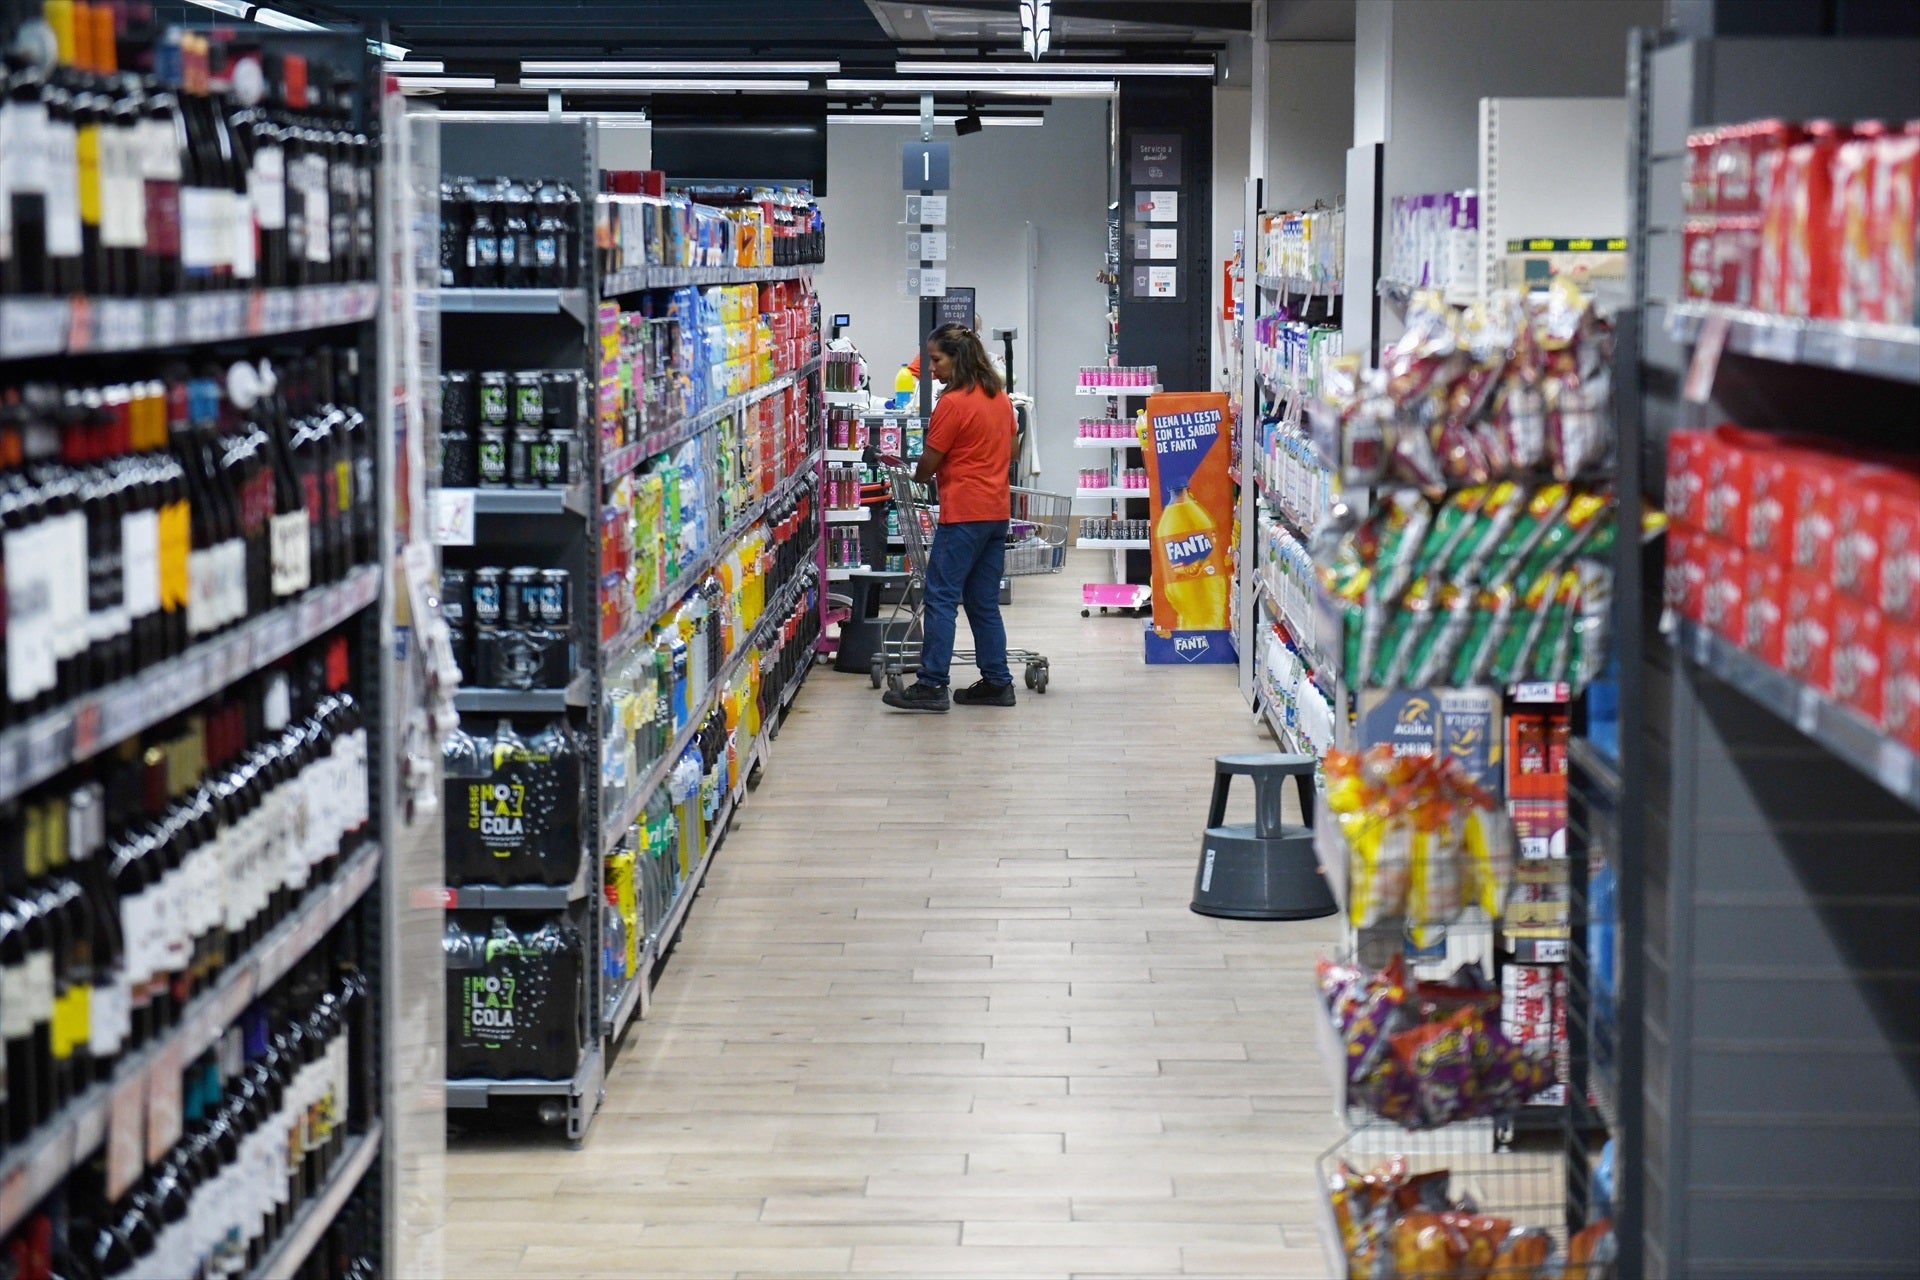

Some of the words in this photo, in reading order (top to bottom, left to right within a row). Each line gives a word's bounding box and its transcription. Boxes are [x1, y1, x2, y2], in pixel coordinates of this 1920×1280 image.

[1140, 145, 1167, 153] Servicio
[922, 151, 930, 181] 1
[1153, 415, 1179, 429] LLENA
[1181, 413, 1192, 426] LA
[1195, 409, 1221, 424] CESTA
[1155, 428, 1173, 441] CON
[1175, 426, 1185, 439] EL
[1187, 423, 1217, 437] SABOR
[1156, 441, 1169, 454] DE
[1171, 438, 1197, 452] FANTA
[1165, 534, 1213, 560] FANTA
[1175, 637, 1209, 651] FANTA
[480, 817, 524, 834] COLA
[472, 1009, 514, 1027] COLA
